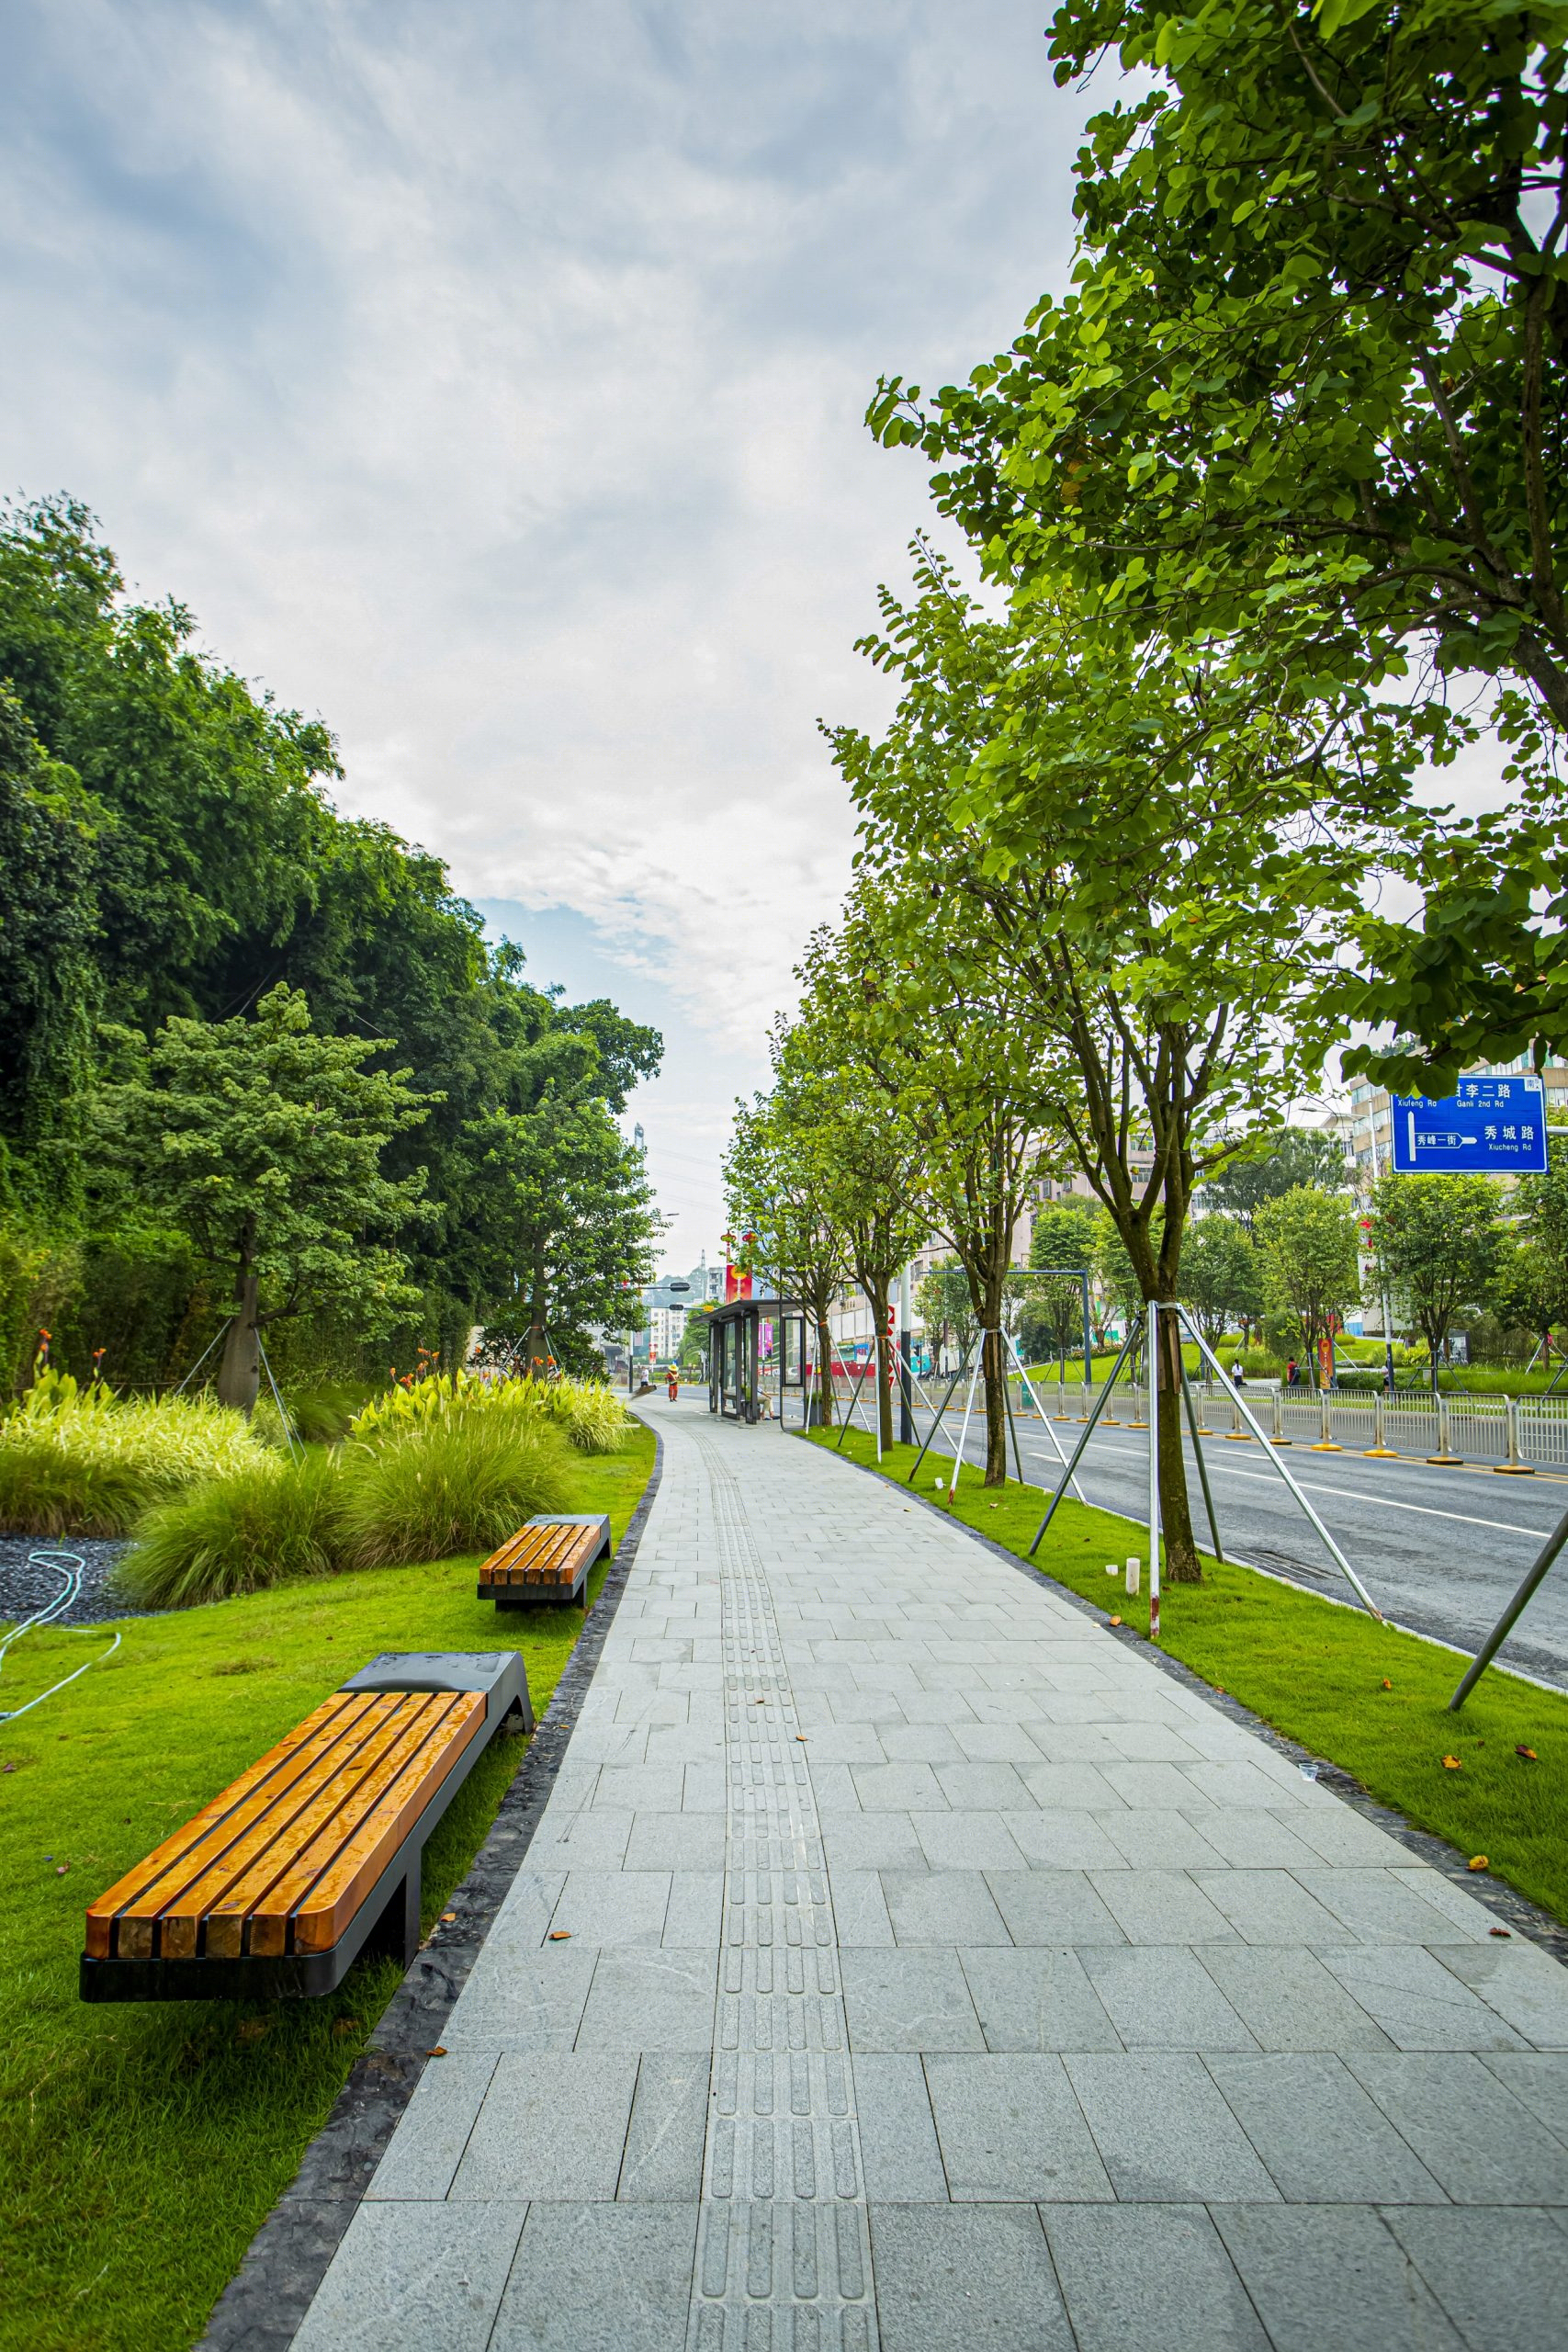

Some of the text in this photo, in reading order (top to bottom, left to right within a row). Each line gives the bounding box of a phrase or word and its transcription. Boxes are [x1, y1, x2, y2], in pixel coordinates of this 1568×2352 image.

[1527, 1079, 1535, 1089] 南
[1397, 1100, 1424, 1108] Xiufeng
[1484, 1125, 1534, 1140] 秀城路
[1417, 1135, 1457, 1146] 秀峰一街
[1489, 1143, 1518, 1152] Xiucheng
